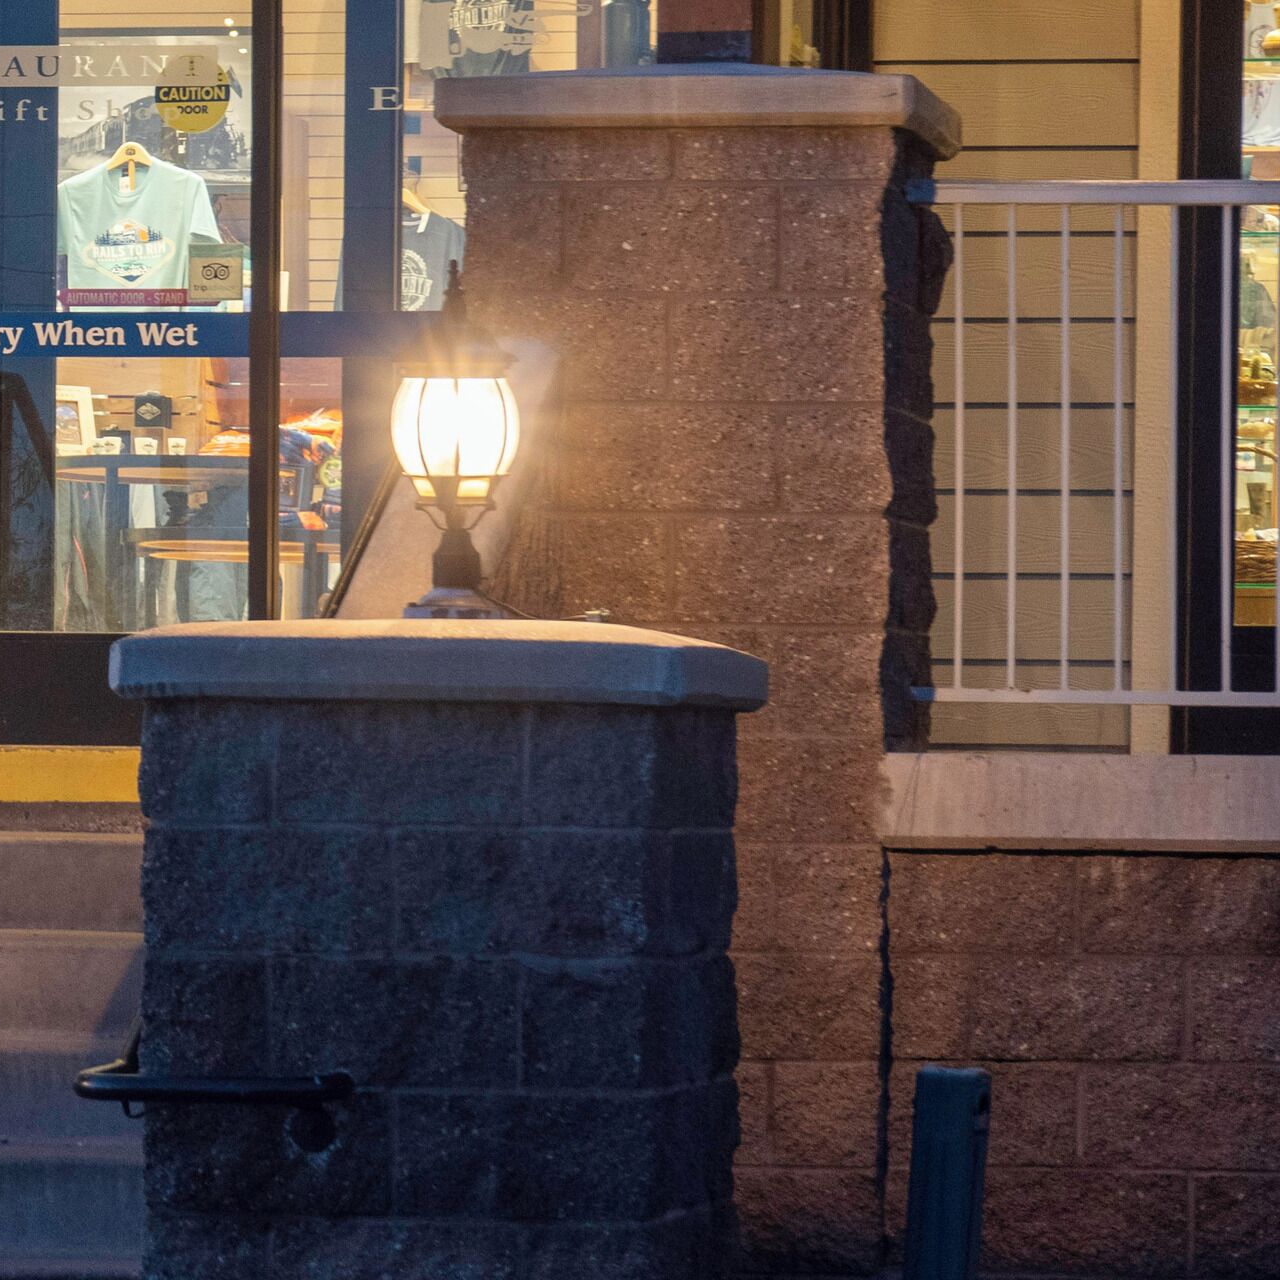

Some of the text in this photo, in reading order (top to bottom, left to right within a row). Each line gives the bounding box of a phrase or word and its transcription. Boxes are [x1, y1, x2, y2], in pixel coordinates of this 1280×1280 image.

[159, 86, 226, 101] CAUTION
[66, 292, 119, 305] AUTOMATIC
[120, 292, 145, 305] DOOR
[154, 292, 184, 305] STAND
[33, 319, 126, 346] When
[136, 321, 199, 346] Wet
